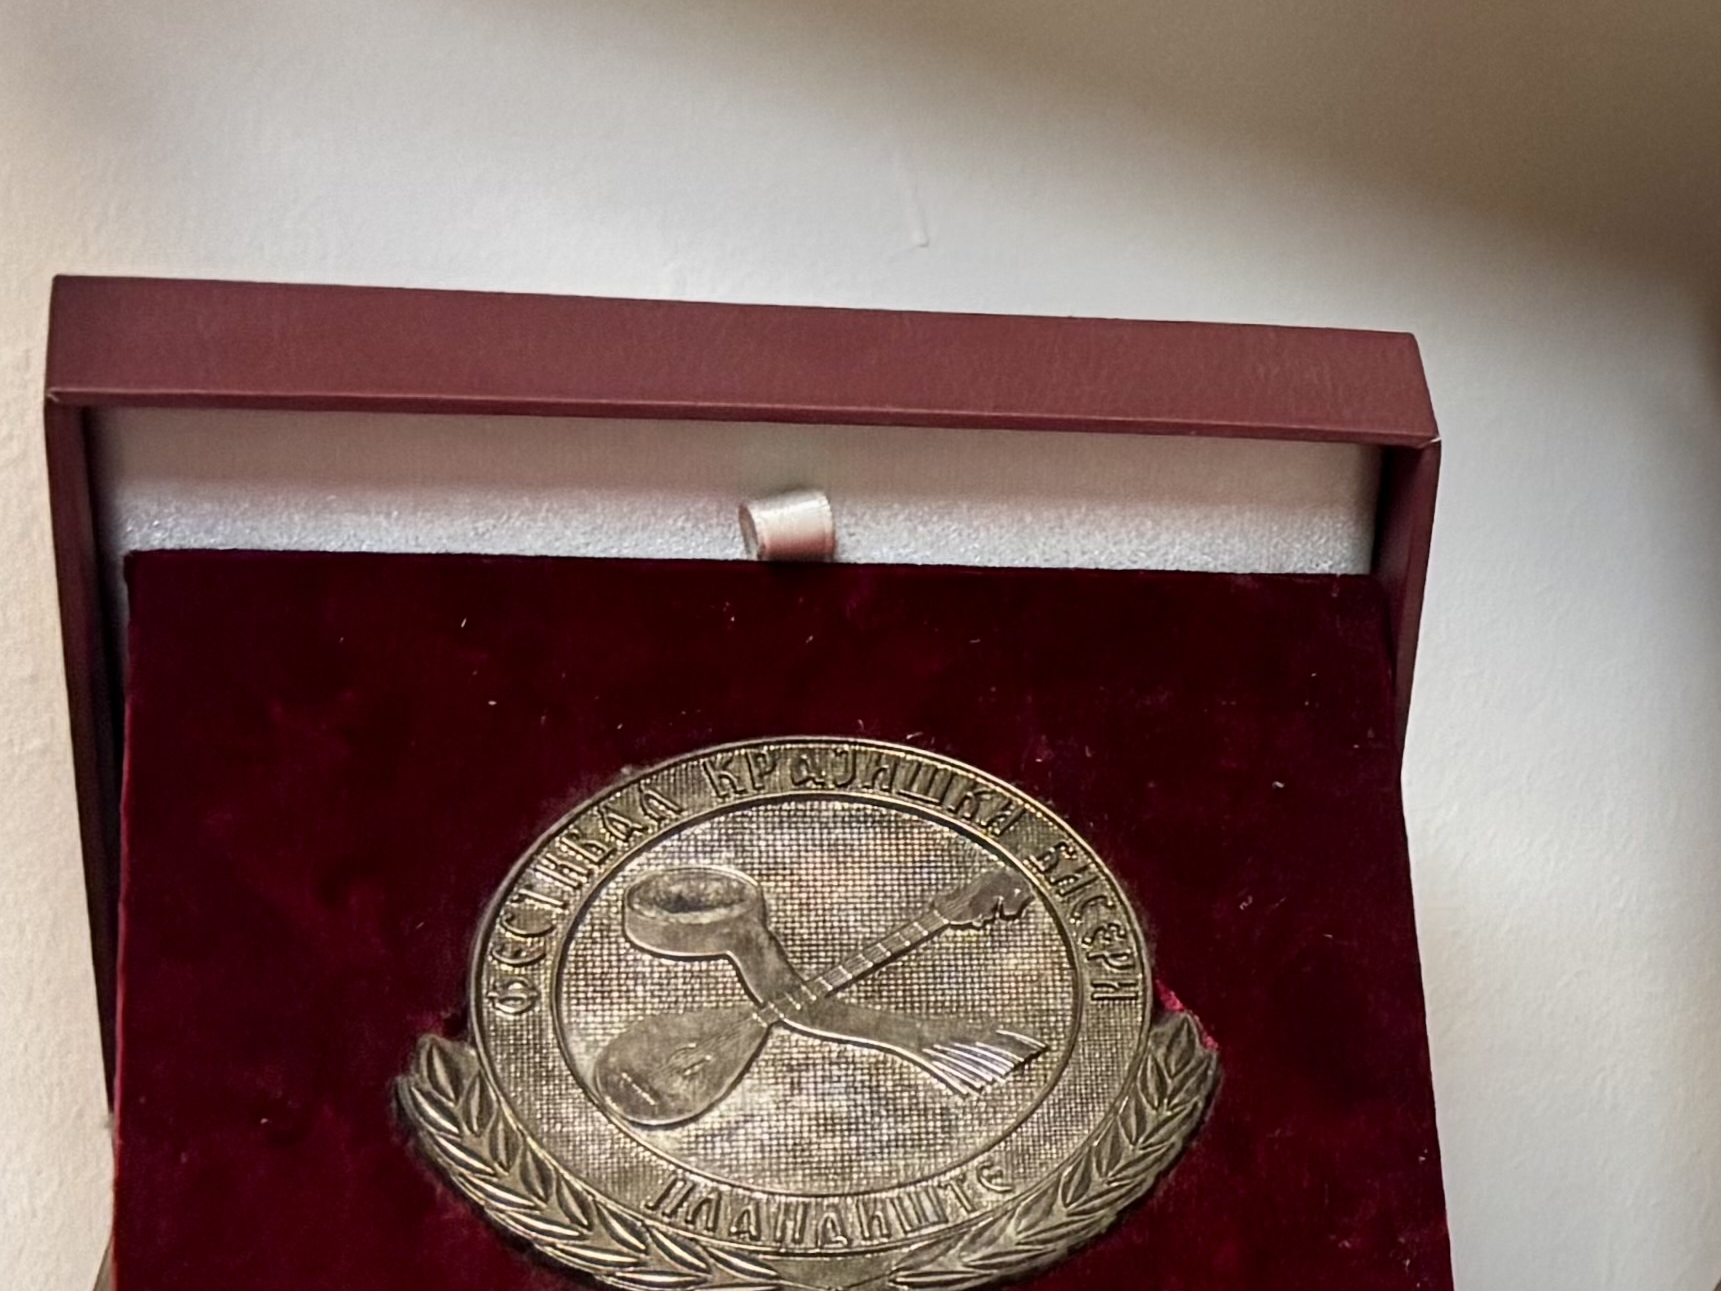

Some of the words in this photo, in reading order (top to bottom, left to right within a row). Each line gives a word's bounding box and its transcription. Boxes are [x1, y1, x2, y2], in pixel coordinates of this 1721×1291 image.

[485, 770, 682, 1020] ФЕСТИВАЛ
[704, 745, 1022, 840] КРАЈИШКИ
[1029, 836, 1142, 1005] БИСЕРИ
[645, 1160, 1026, 1250] ПЛАНДИШТЕ
